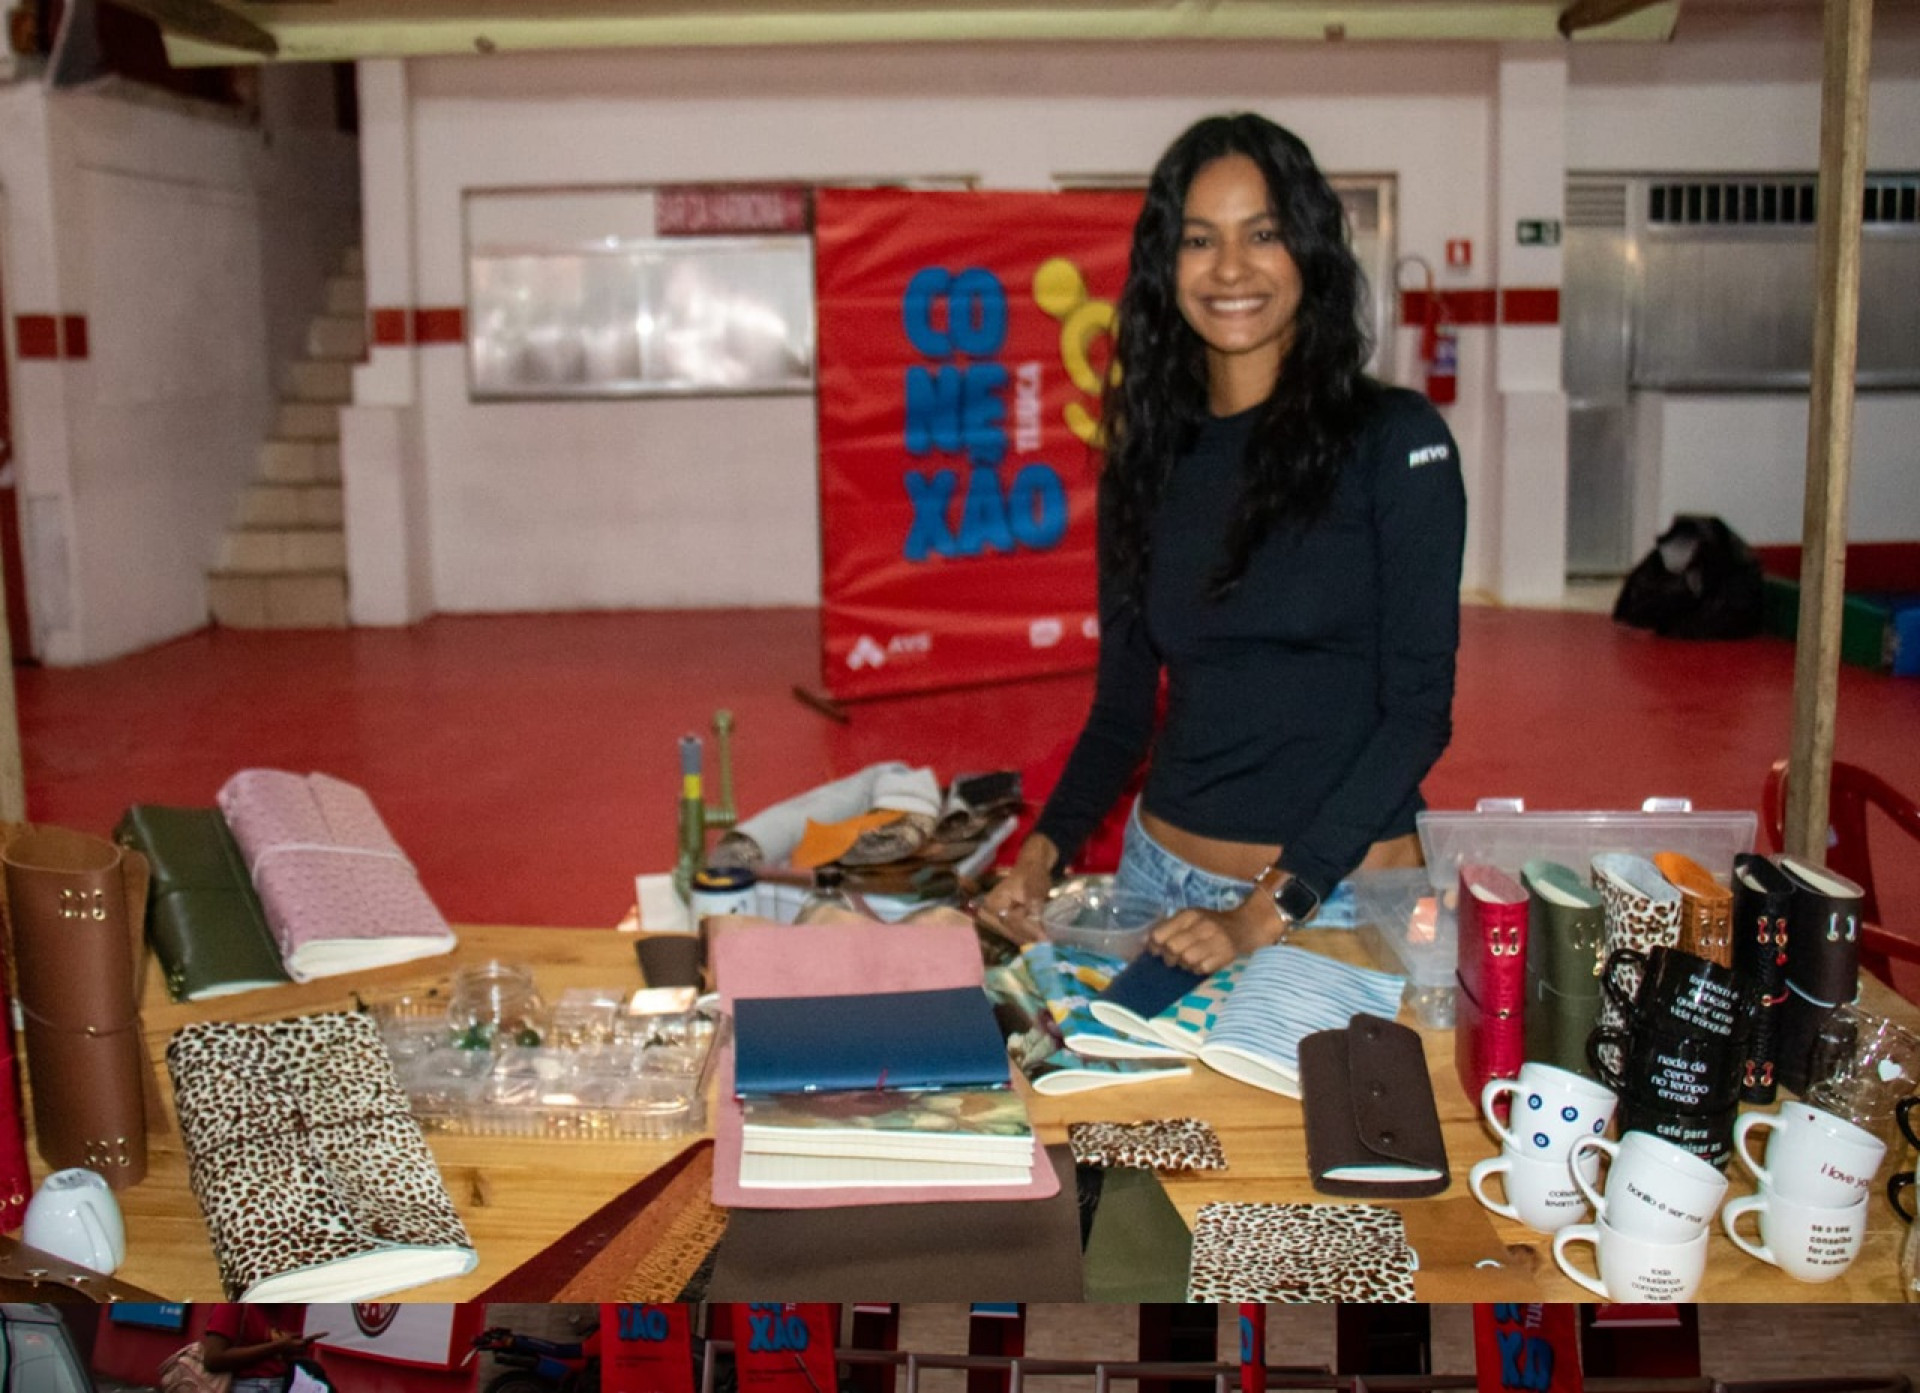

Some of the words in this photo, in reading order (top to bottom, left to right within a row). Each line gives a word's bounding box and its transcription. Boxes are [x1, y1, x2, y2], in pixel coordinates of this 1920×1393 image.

[903, 265, 1007, 358] CO
[905, 361, 1009, 455] NE
[903, 447, 1068, 562] XÃO
[1657, 1054, 1687, 1069] nada
[1651, 1074, 1667, 1087] no
[1670, 1080, 1709, 1095] tempo
[1663, 1068, 1696, 1083] certo
[1658, 1088, 1699, 1105] errado
[1656, 1123, 1683, 1138] café
[1683, 1128, 1708, 1141] para
